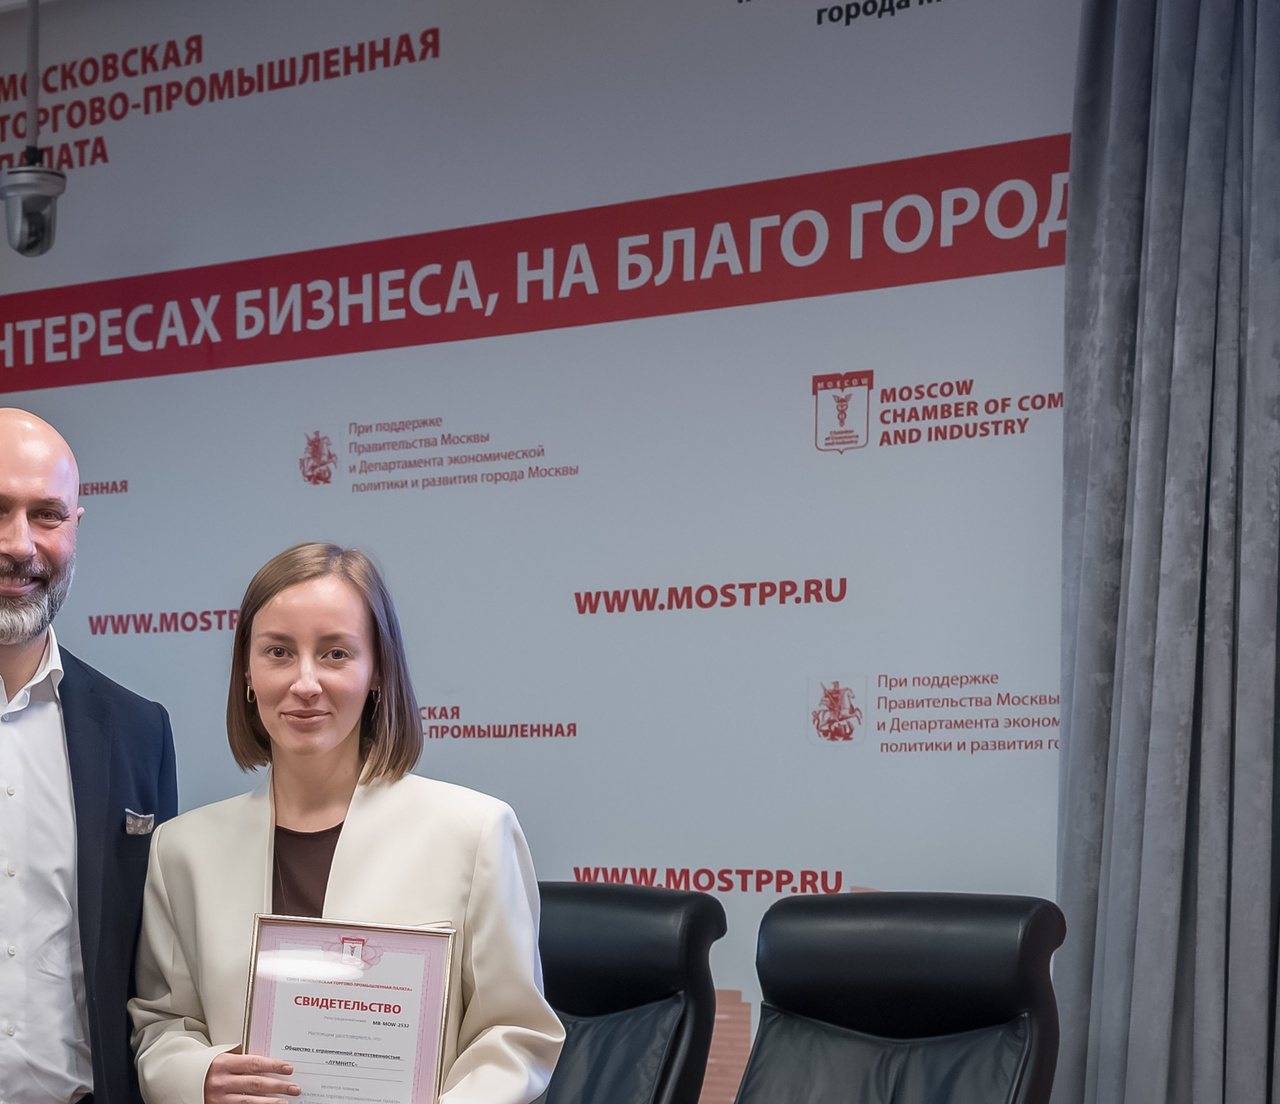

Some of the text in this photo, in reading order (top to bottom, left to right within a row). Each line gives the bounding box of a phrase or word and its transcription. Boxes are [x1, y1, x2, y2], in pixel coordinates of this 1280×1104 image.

[235, 259, 499, 340] БИЗНЕСА,
[516, 243, 599, 304] НА
[618, 209, 830, 291] БЛАГО
[880, 379, 974, 404] MOSCOW
[879, 400, 979, 425] CHAMBER
[984, 397, 1011, 415] OF
[349, 416, 443, 437] При поддержке
[879, 417, 1030, 447] AND INDUSTRY
[349, 430, 490, 455] Правительства Москвы
[349, 444, 545, 475] и Департамента экономической
[352, 464, 579, 493] политики и развития города Москвы
[574, 577, 847, 615] WWW.MOSTPP.RU
[877, 673, 999, 691] При поддержке
[877, 692, 1060, 713] Правительства Москвы
[877, 721, 886, 732] и
[889, 717, 999, 734] Департамента
[880, 740, 952, 753] политики
[956, 740, 966, 751] и
[970, 739, 1043, 754] развития
[573, 866, 842, 894] WWW.MOSTPP.RU
[293, 995, 402, 1015] СВИДЕТЕЛЬСТВО
